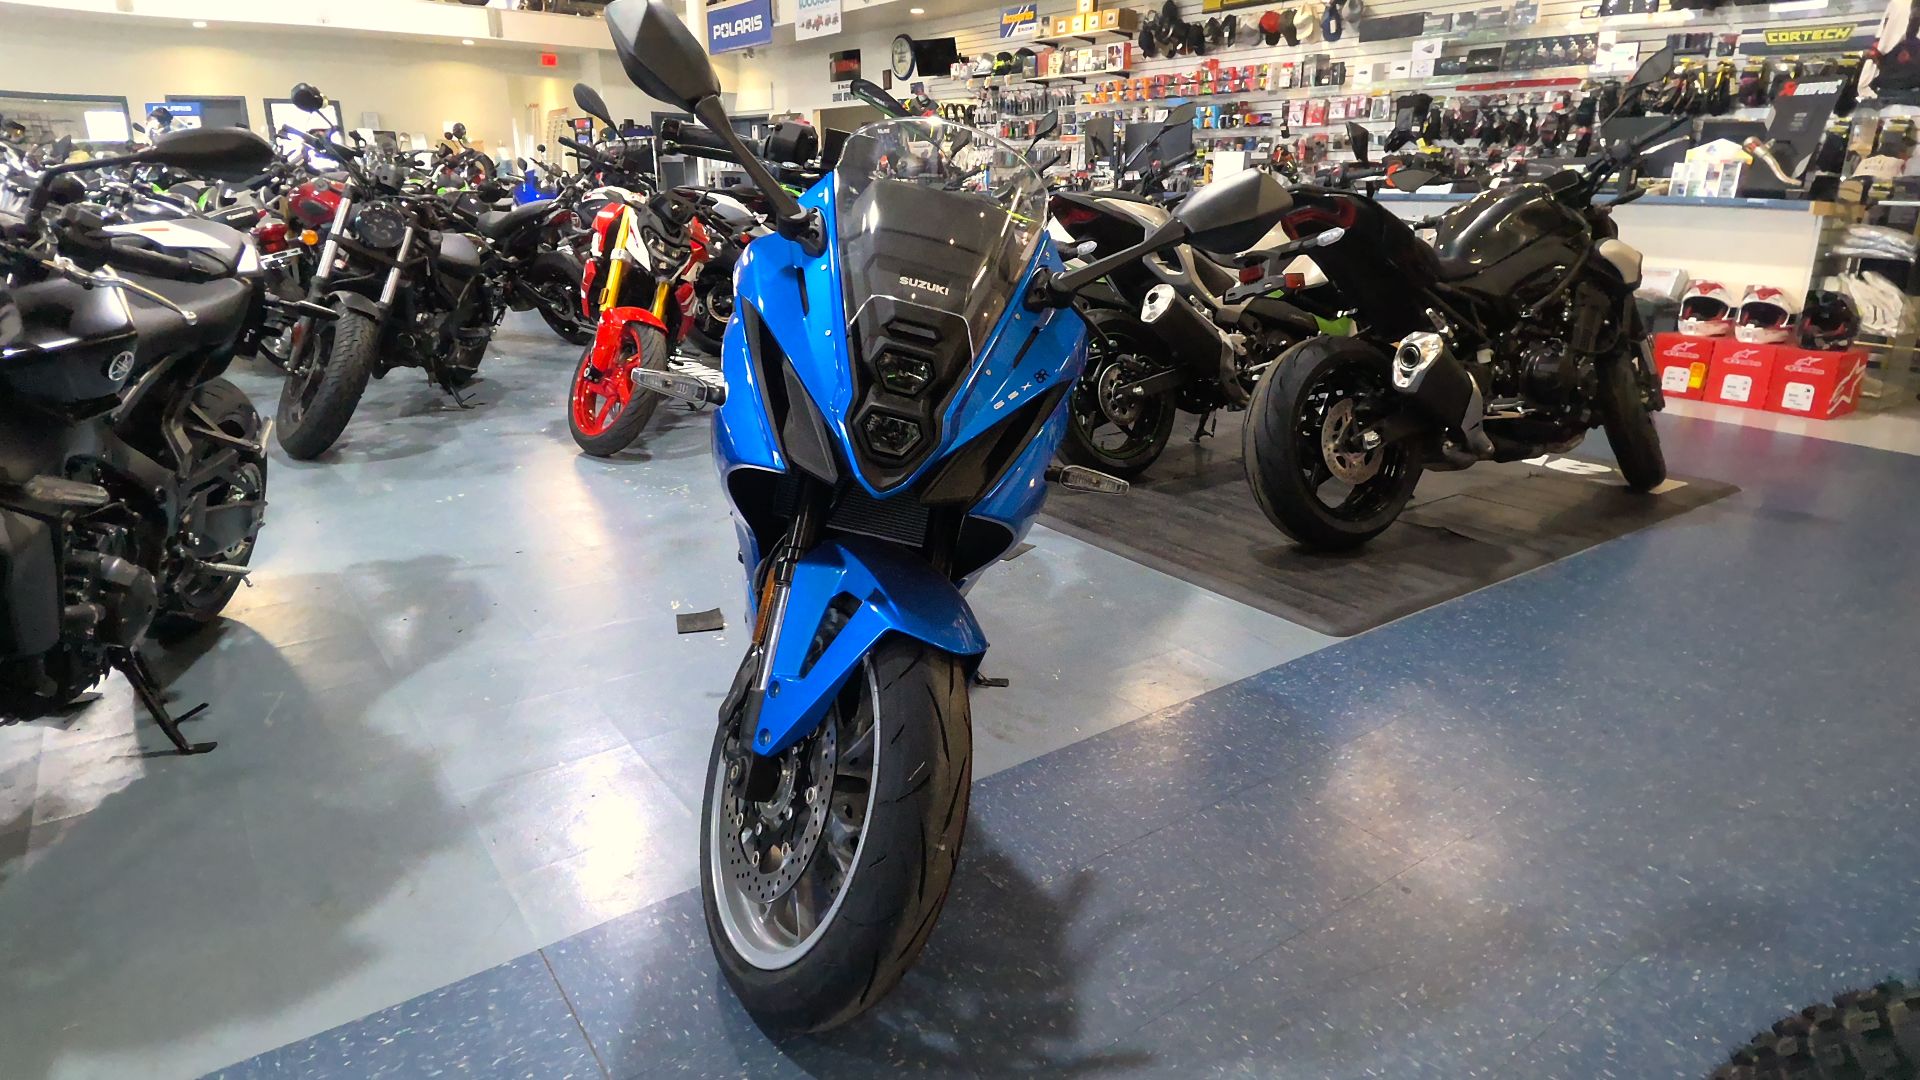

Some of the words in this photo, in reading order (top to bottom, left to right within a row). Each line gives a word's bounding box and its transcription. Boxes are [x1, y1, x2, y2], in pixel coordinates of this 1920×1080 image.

[713, 14, 763, 40] POLARIS
[1767, 28, 1850, 42] CORTECH
[899, 276, 949, 295] SUZUKI
